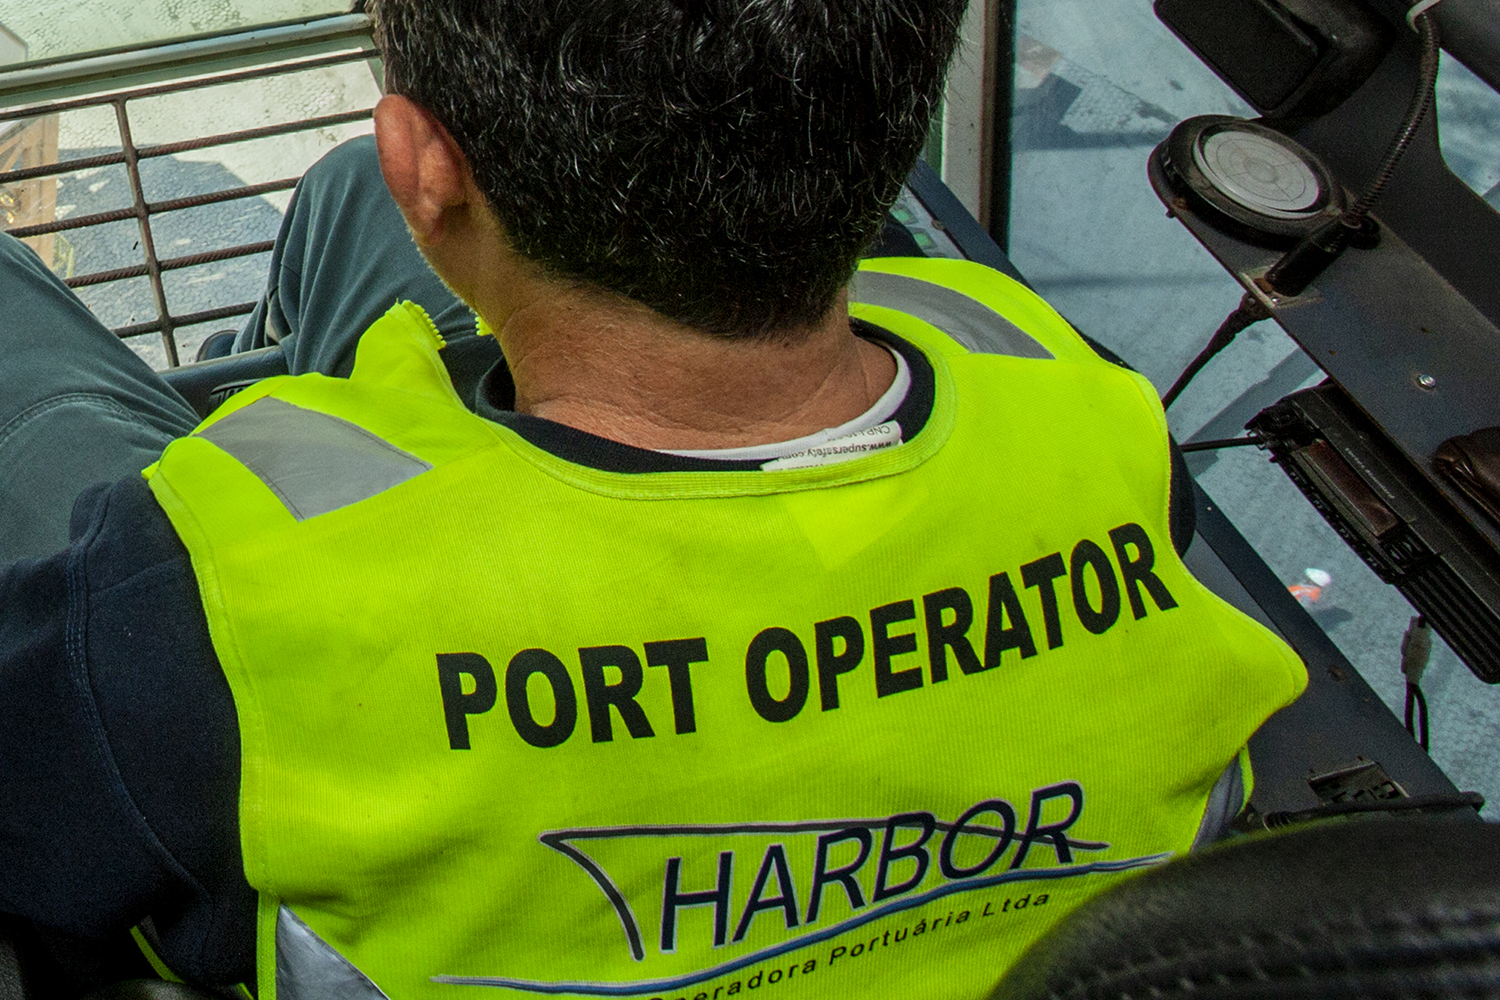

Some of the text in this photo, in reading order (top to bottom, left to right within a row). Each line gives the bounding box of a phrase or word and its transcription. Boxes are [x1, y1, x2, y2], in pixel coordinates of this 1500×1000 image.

[435, 521, 1180, 751] PORT OPERATOR
[648, 893, 1051, 1000] eradora Portuária Ltda
[660, 780, 1085, 952] HARBOR
